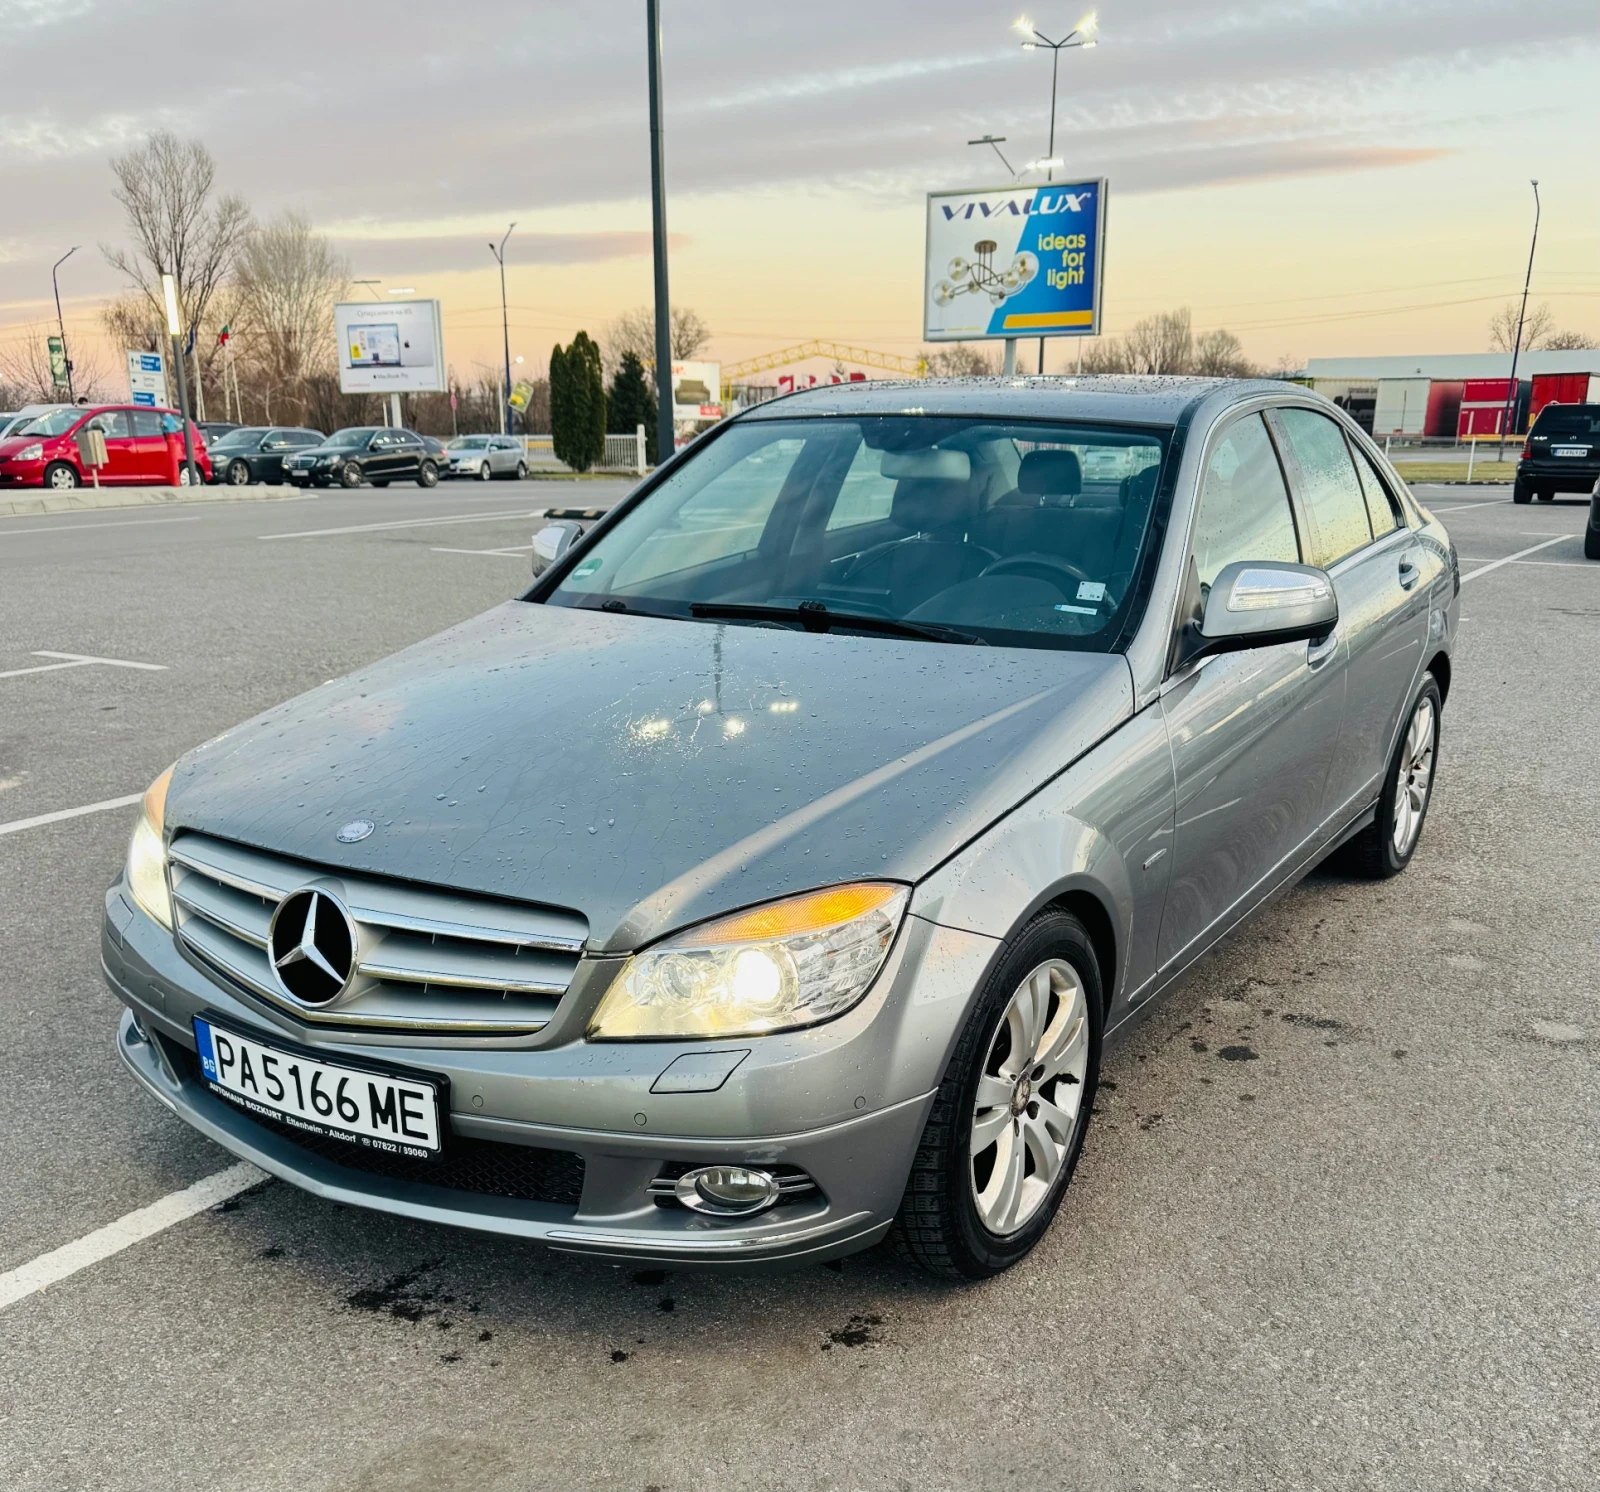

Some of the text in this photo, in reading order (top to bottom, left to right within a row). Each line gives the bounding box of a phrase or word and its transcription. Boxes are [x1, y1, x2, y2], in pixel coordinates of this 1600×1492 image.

[1037, 233, 1086, 251] ideas
[1062, 250, 1086, 267] for
[1046, 267, 1085, 290] light
[202, 1055, 216, 1073] BG
[209, 1082, 245, 1106] AUTOHAUS
[245, 1100, 282, 1120] BOZKURT
[286, 1116, 323, 1135] Ettenheim
[329, 1129, 356, 1143] Altdorf
[372, 1139, 397, 1153] 07822
